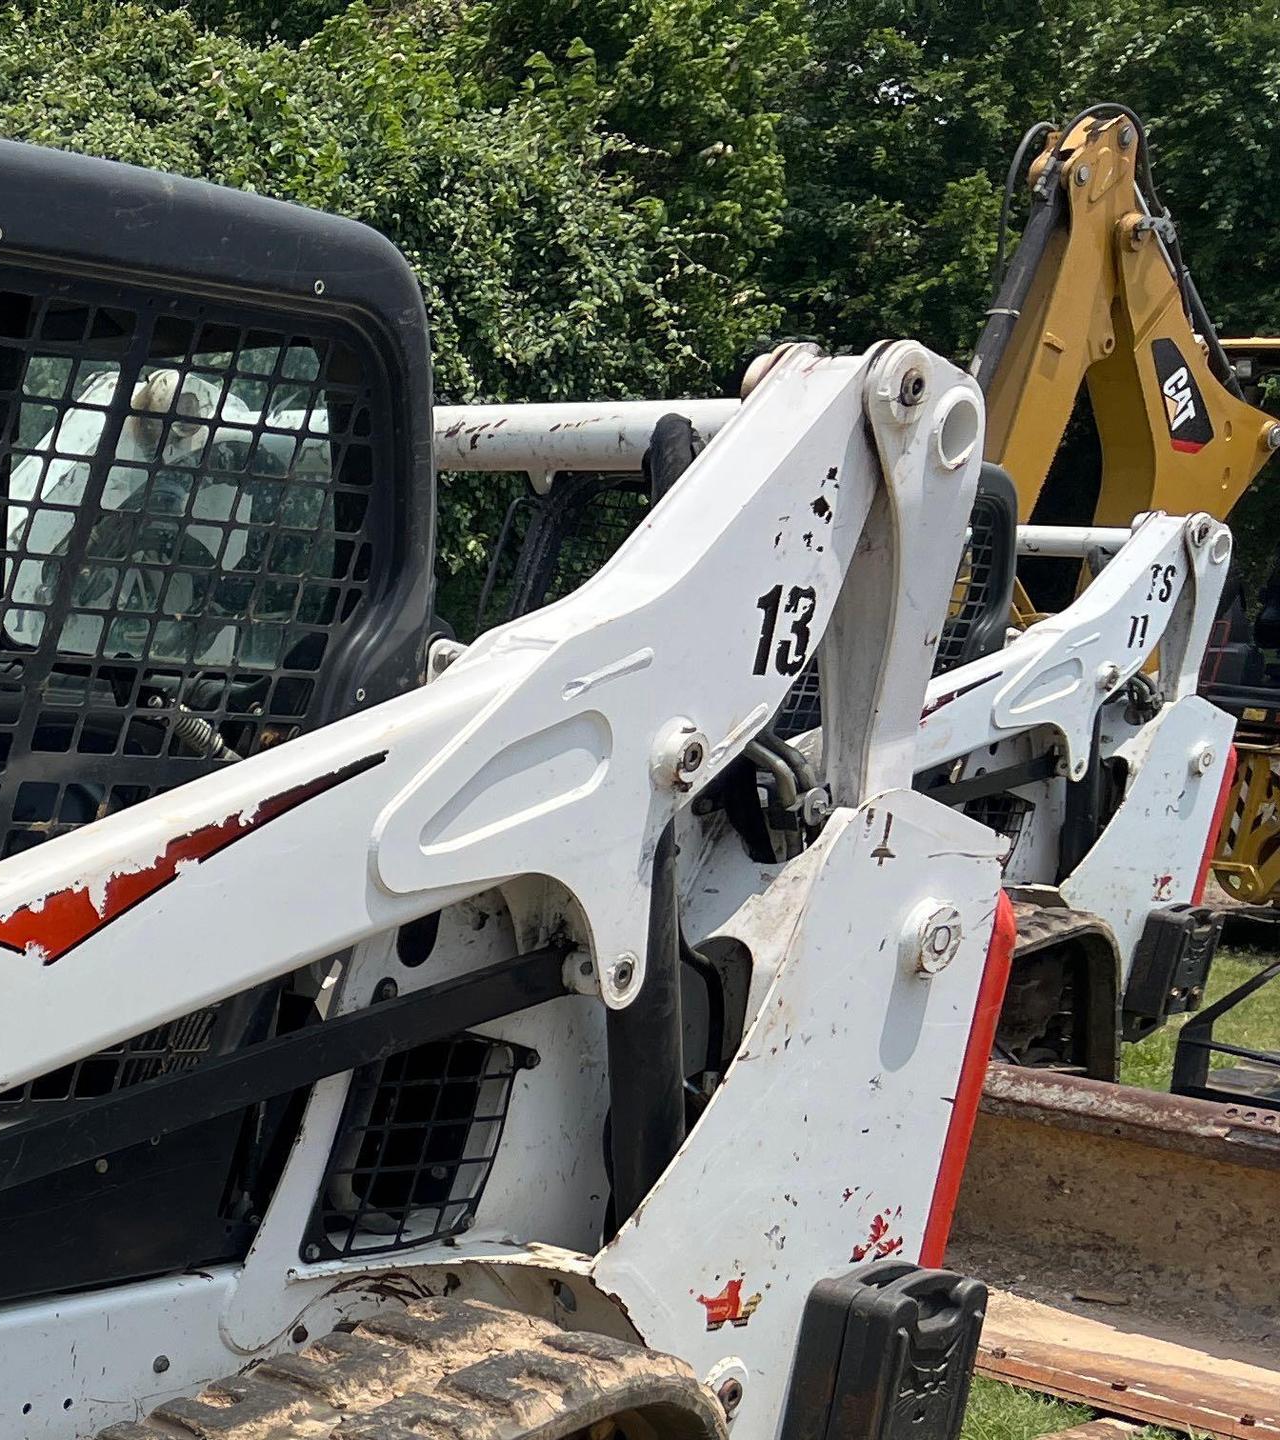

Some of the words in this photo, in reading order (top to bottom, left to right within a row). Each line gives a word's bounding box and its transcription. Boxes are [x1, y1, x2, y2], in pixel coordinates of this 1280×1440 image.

[1162, 366, 1196, 431] CAT
[752, 584, 817, 676] 13
[1127, 614, 1149, 648] 11
